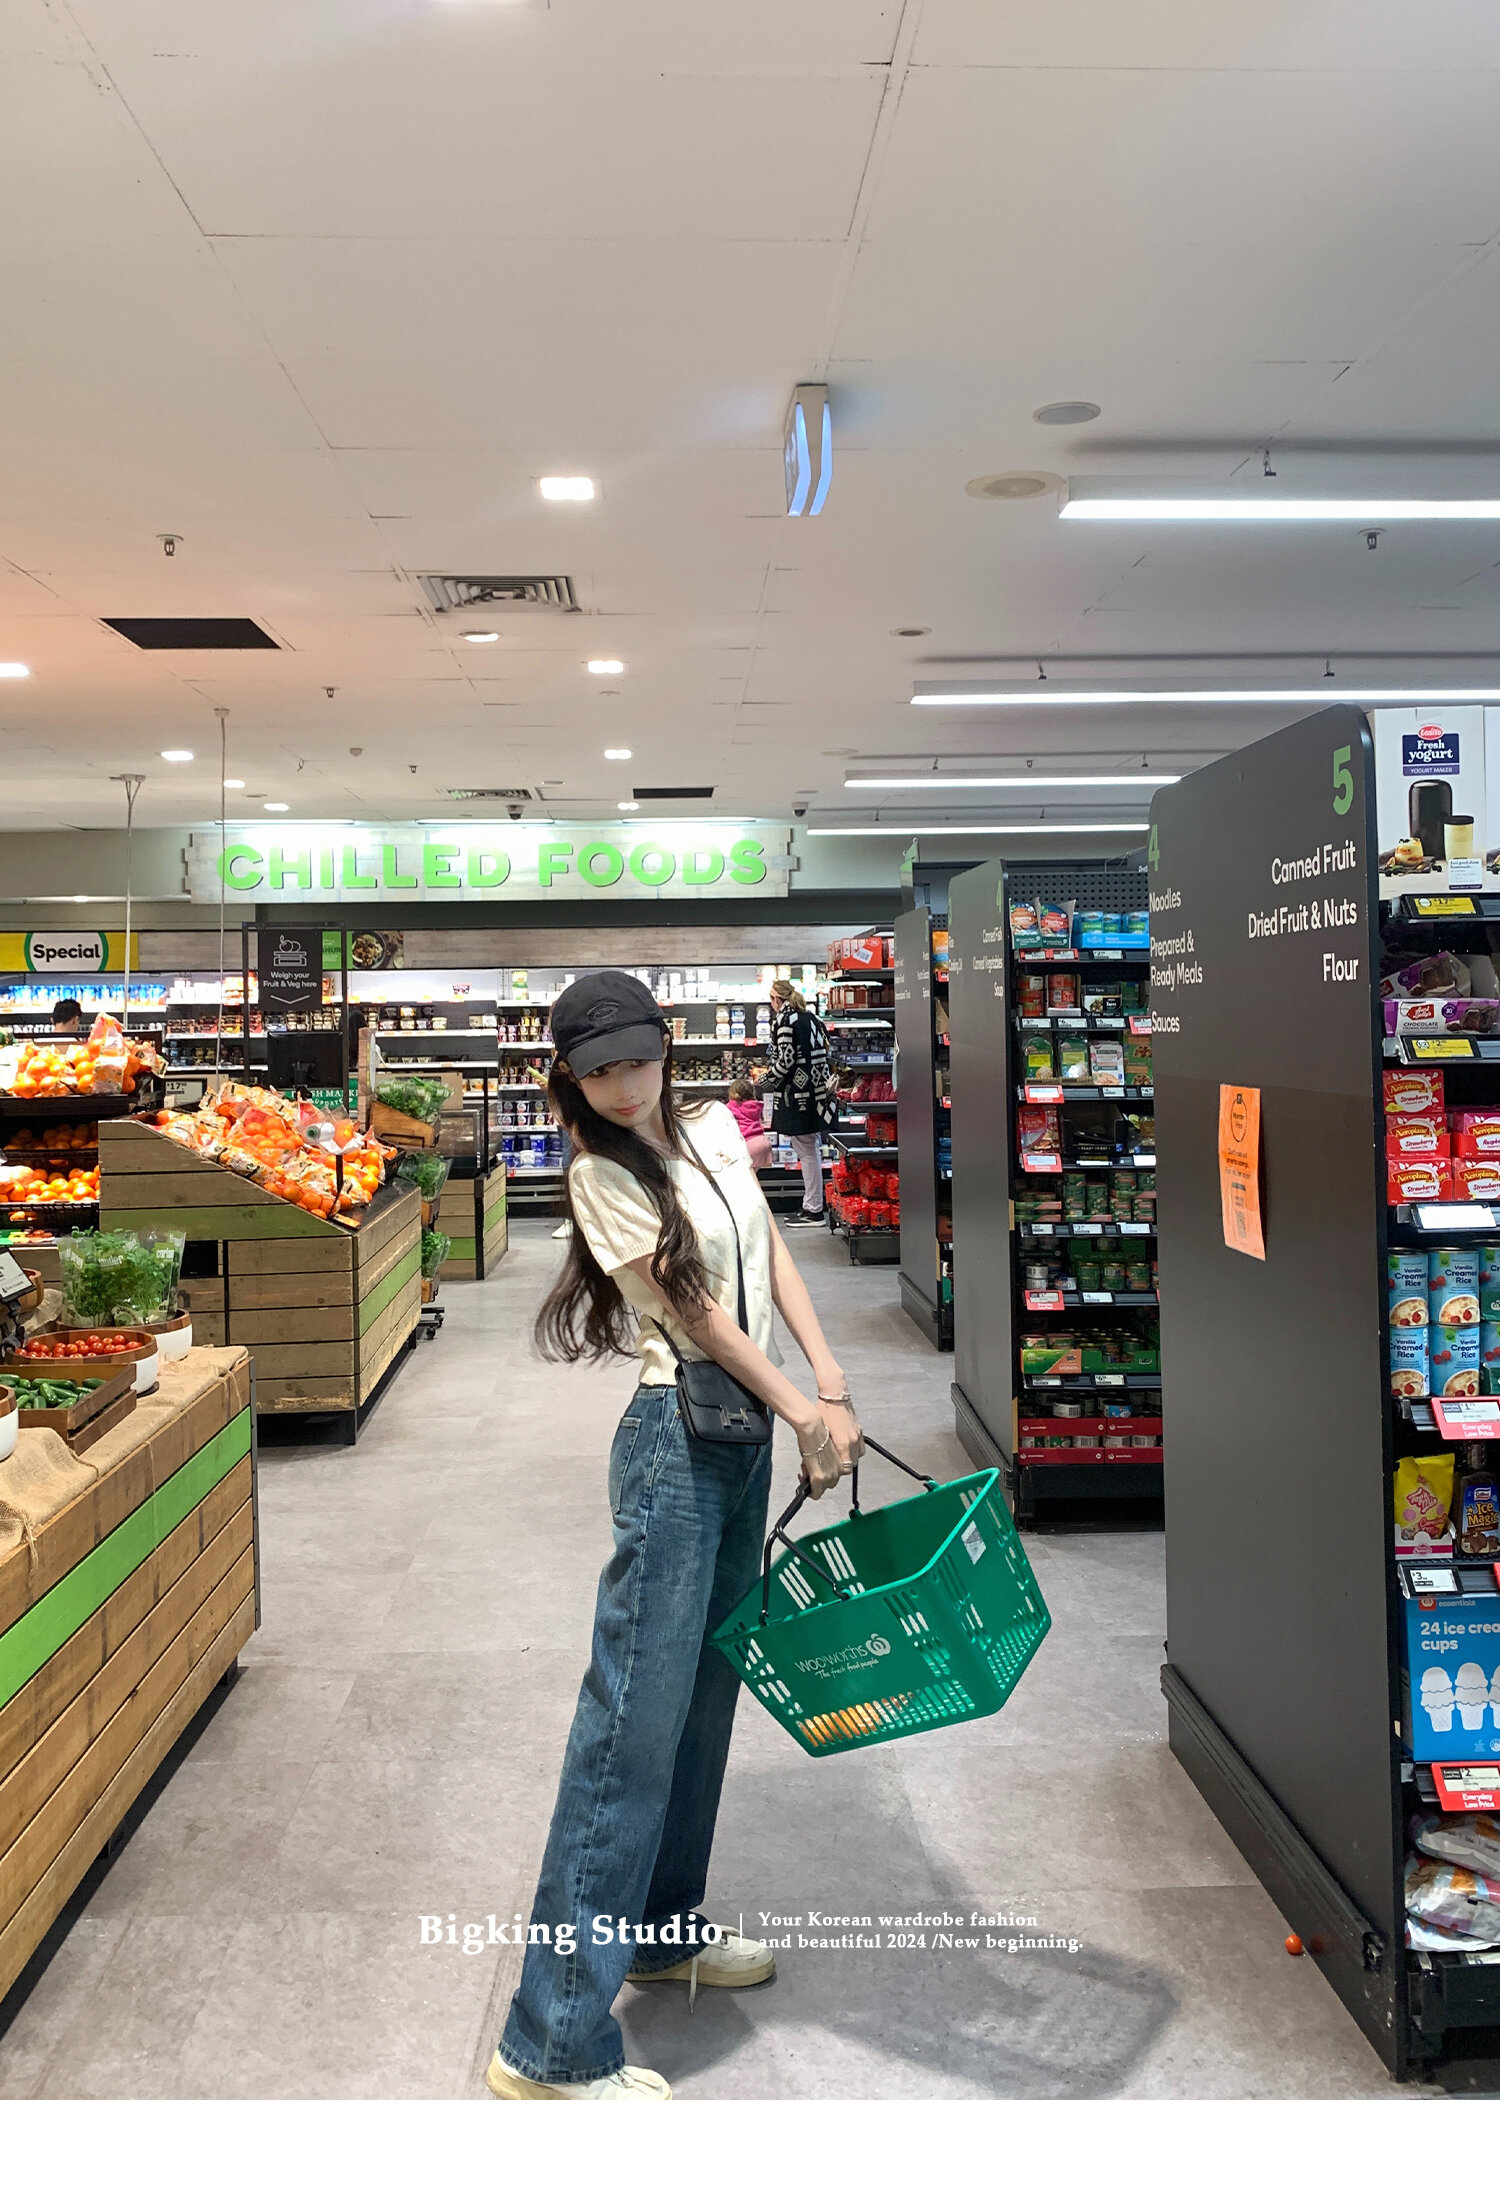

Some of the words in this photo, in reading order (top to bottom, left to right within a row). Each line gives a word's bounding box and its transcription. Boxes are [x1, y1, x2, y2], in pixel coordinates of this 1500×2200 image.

[1417, 739, 1445, 750] Fresh
[1408, 749, 1454, 763] yogurt
[1333, 744, 1354, 816] 5
[1148, 824, 1160, 872] 4
[217, 844, 512, 890] CHILLED
[538, 841, 767, 888] FOODS
[1271, 847, 1321, 885] Canned
[1323, 839, 1356, 874] Fruit
[1149, 888, 1182, 913] Noodles
[1248, 908, 1278, 938] Dried
[1280, 904, 1309, 934] Fruit
[1311, 901, 1322, 930] &
[1324, 898, 1358, 928] Nuts
[1150, 931, 1186, 962] Prepared
[1187, 929, 1195, 952] &
[33, 944, 101, 963] Special
[1323, 953, 1359, 982] Flour
[270, 971, 294, 981] Weigh
[294, 973, 310, 981] your
[1151, 963, 1175, 992] Ready
[1177, 961, 1203, 984] Meals
[263, 980, 280, 988] Fruit
[281, 980, 287, 988] &
[288, 980, 301, 989] Veg
[302, 980, 318, 988] here
[1151, 1011, 1181, 1033] Sauces
[1390, 1082, 1423, 1094] Aeroplane
[1401, 1094, 1429, 1103] Strawberry
[1395, 1127, 1428, 1138] Aeroplane
[1472, 1126, 1500, 1136] Aeroplan
[1405, 1139, 1434, 1147] Strawberry
[1397, 1173, 1430, 1183] Aeroplane
[1463, 1171, 1496, 1183] Aeroplane
[1407, 1184, 1436, 1193] Strawberry
[1476, 1502, 1494, 1515] Ice
[1467, 1512, 1499, 1526] Magic
[1420, 1622, 1440, 1636] 24
[1443, 1621, 1466, 1635] ice
[1421, 1639, 1459, 1654] cups
[815, 1669, 831, 1679] The
[1462, 1793, 1493, 1804] Everyday
[1478, 1800, 1495, 1808] Price
